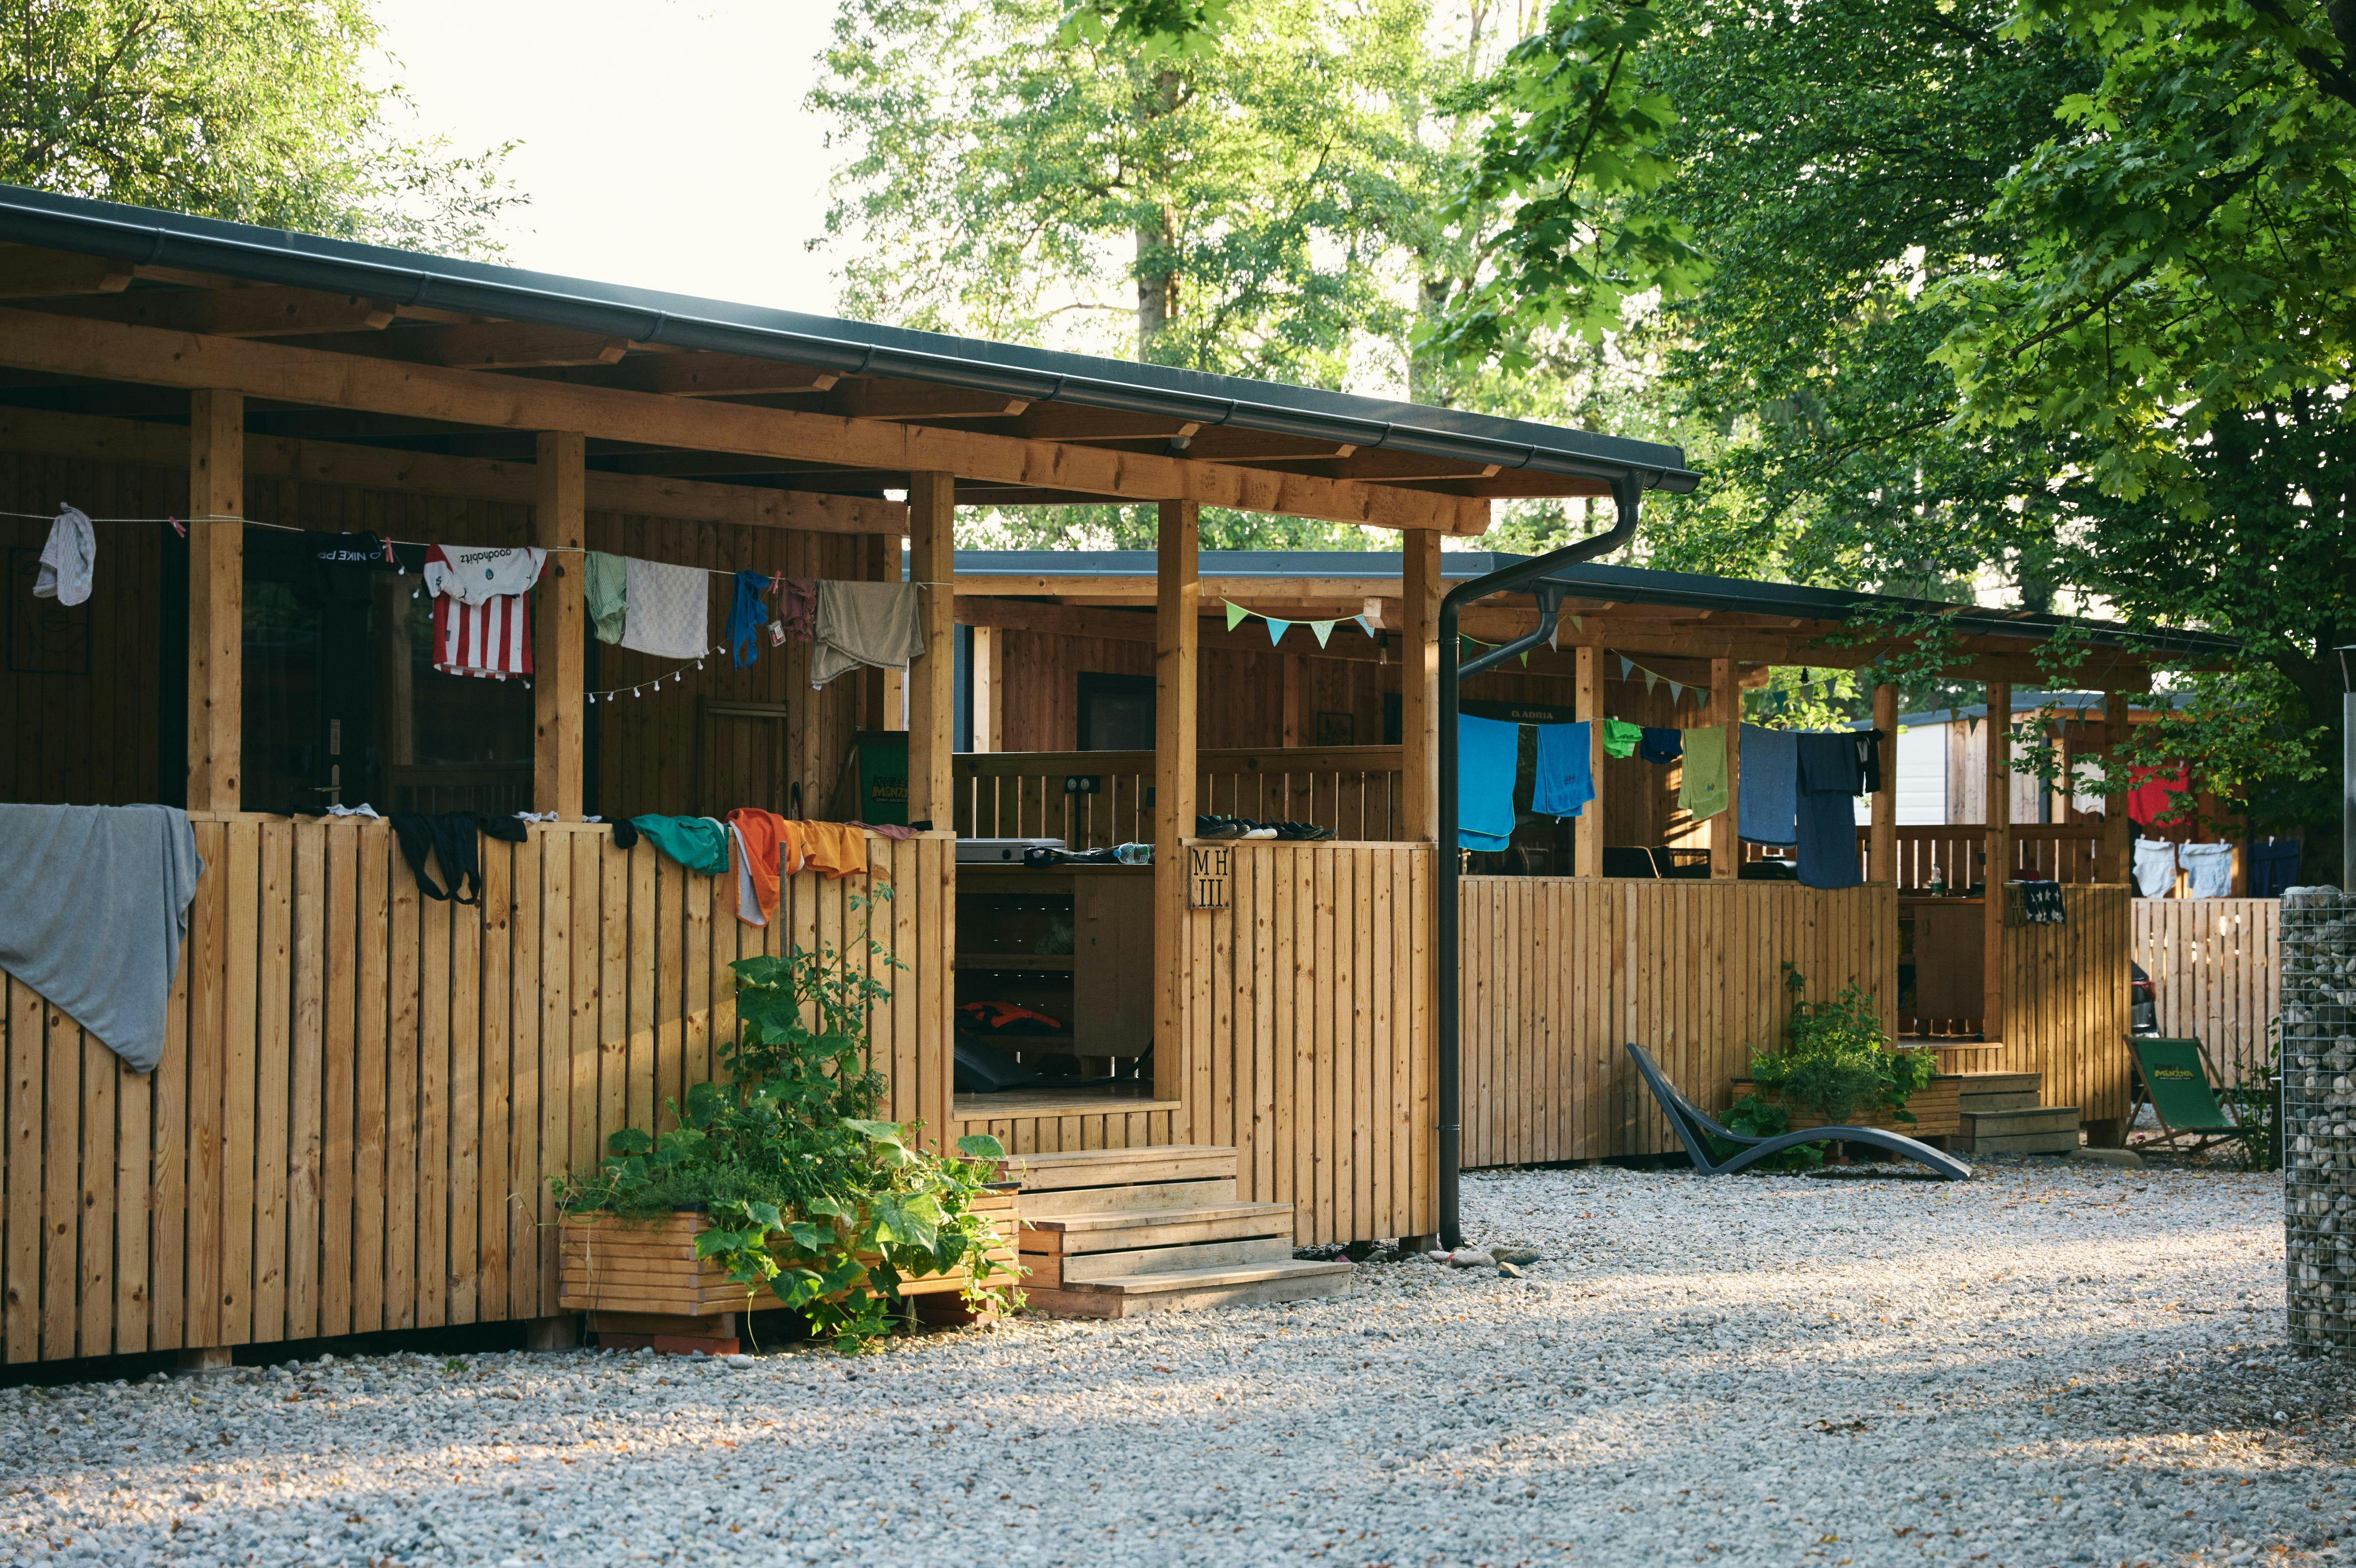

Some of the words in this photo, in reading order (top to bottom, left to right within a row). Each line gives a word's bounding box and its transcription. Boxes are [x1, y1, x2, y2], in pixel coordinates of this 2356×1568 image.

[338, 550, 367, 561] NIKE
[1521, 711, 1553, 720] ADRIA
[1199, 879, 1223, 907] III
